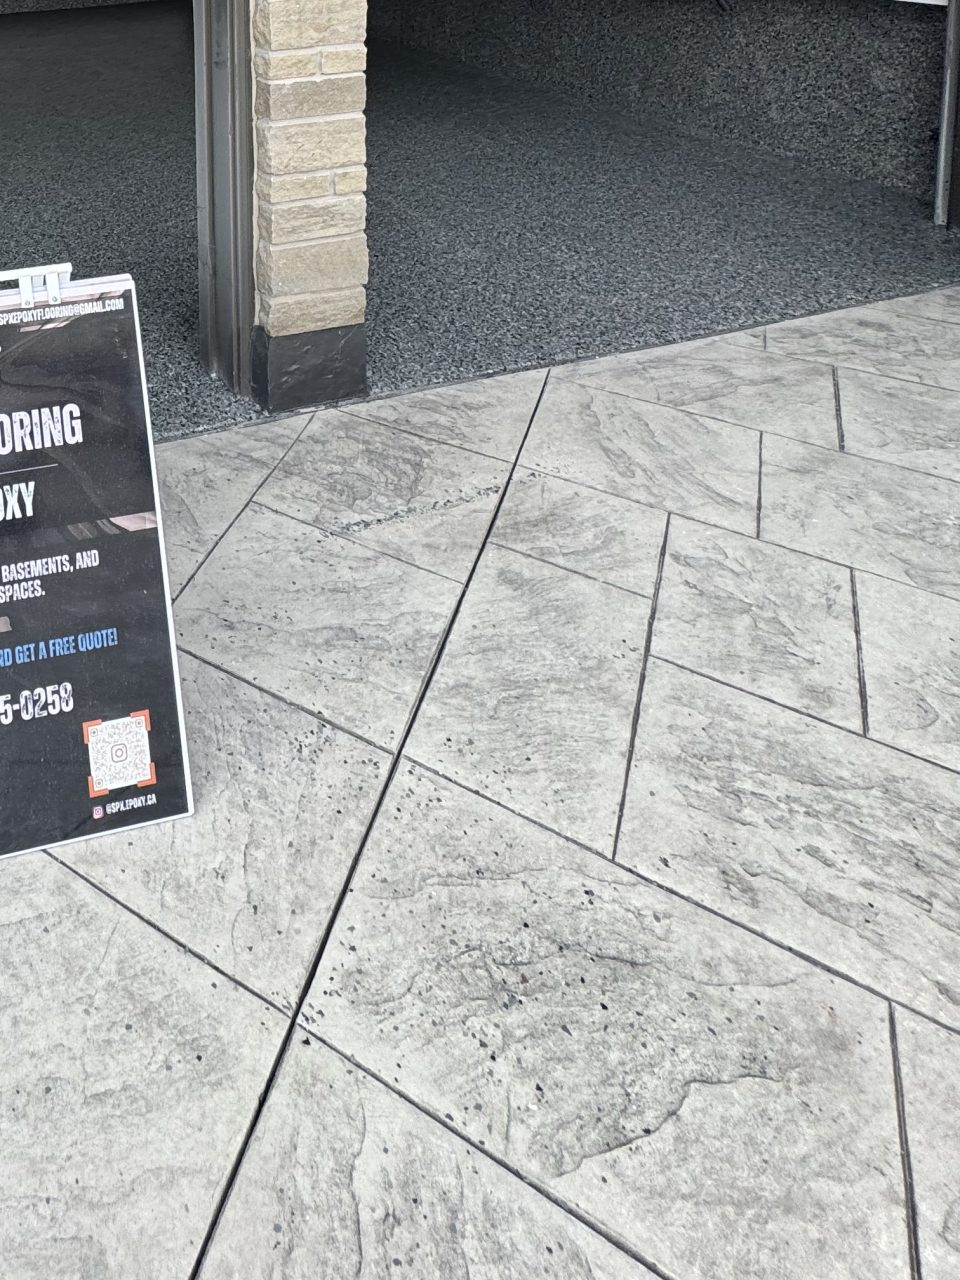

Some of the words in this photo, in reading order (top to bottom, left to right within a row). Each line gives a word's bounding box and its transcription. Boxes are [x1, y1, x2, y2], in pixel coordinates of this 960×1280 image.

[1, 554, 74, 583] BASEMENTS,
[75, 549, 100, 570] AND
[15, 643, 35, 665] GET
[38, 641, 48, 660] A
[49, 635, 76, 658] FREE
[77, 627, 118, 652] QUOTE!
[105, 793, 157, 815] @SPX.EPOXY.CA
